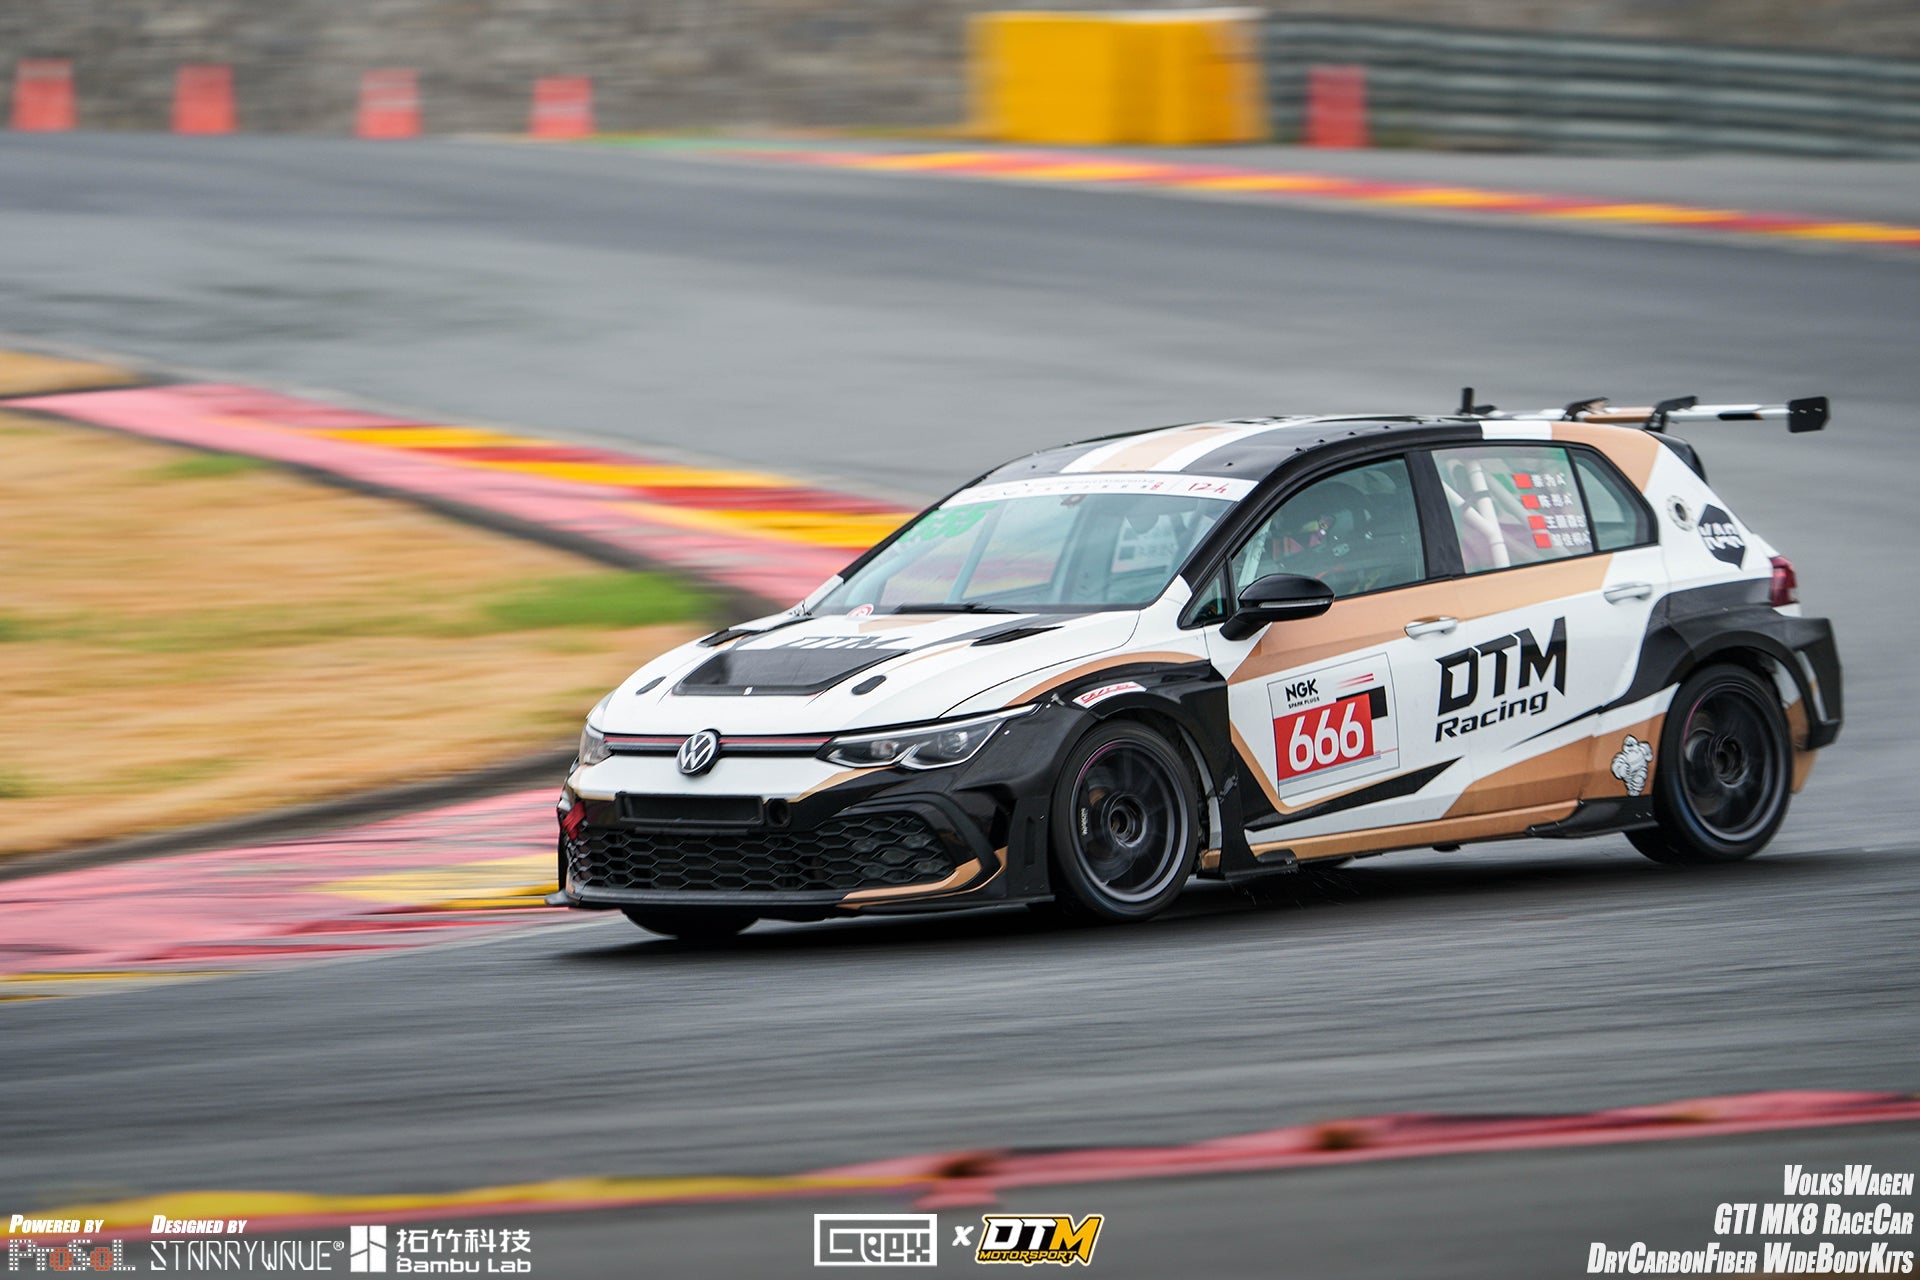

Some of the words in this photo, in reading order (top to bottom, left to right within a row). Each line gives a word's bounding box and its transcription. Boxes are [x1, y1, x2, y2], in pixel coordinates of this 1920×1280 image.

[1285, 678, 1319, 702] NGK
[1435, 616, 1567, 717] DTM
[1288, 701, 1365, 773] 666
[1435, 691, 1549, 743] Racing
